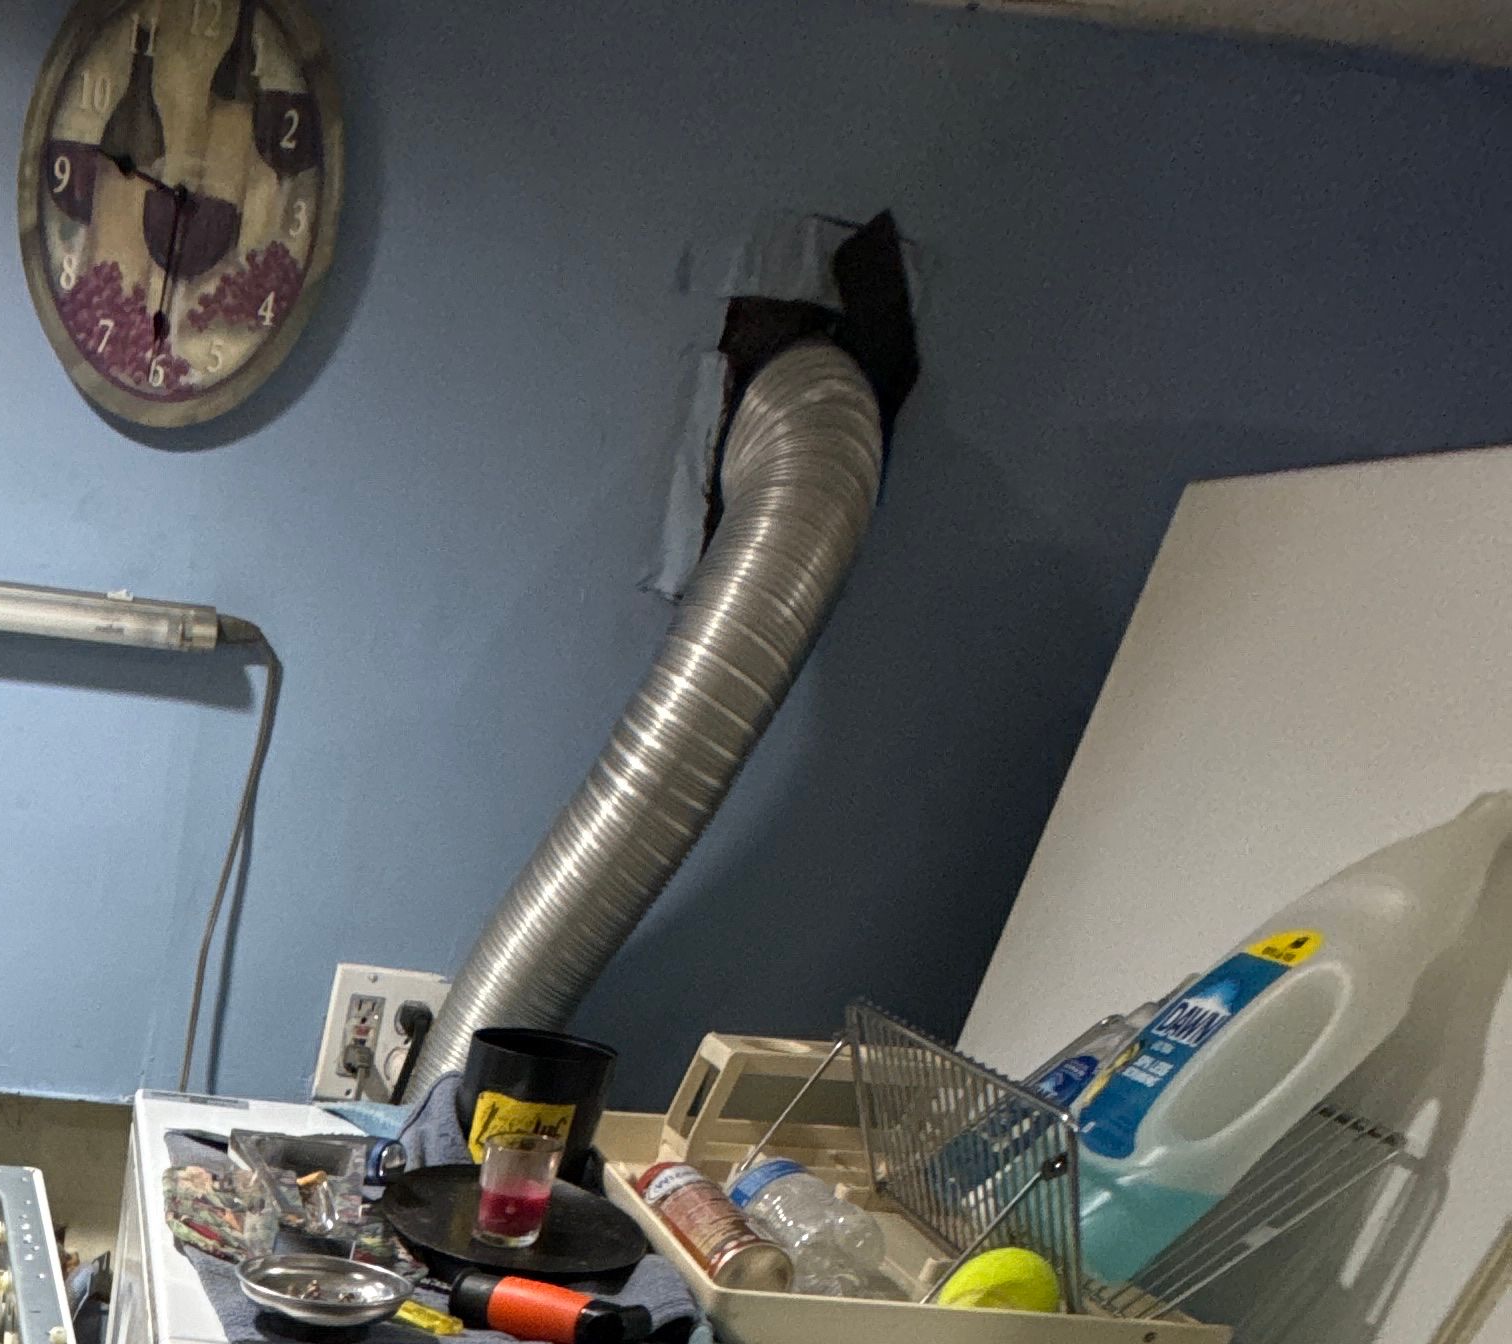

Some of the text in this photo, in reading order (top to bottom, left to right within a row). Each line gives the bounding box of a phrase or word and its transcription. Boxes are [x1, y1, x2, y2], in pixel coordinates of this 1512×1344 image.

[131, 12, 158, 57] 11
[250, 33, 265, 77] 1
[81, 71, 111, 111] 10
[279, 109, 300, 150] 2
[53, 155, 72, 194] 9
[288, 200, 308, 237] 3
[59, 253, 77, 291] 8
[257, 291, 275, 327] 4
[97, 319, 116, 353] 7
[148, 354, 166, 388] 6
[206, 342, 224, 374] 5
[1150, 998, 1232, 1048] DAWN
